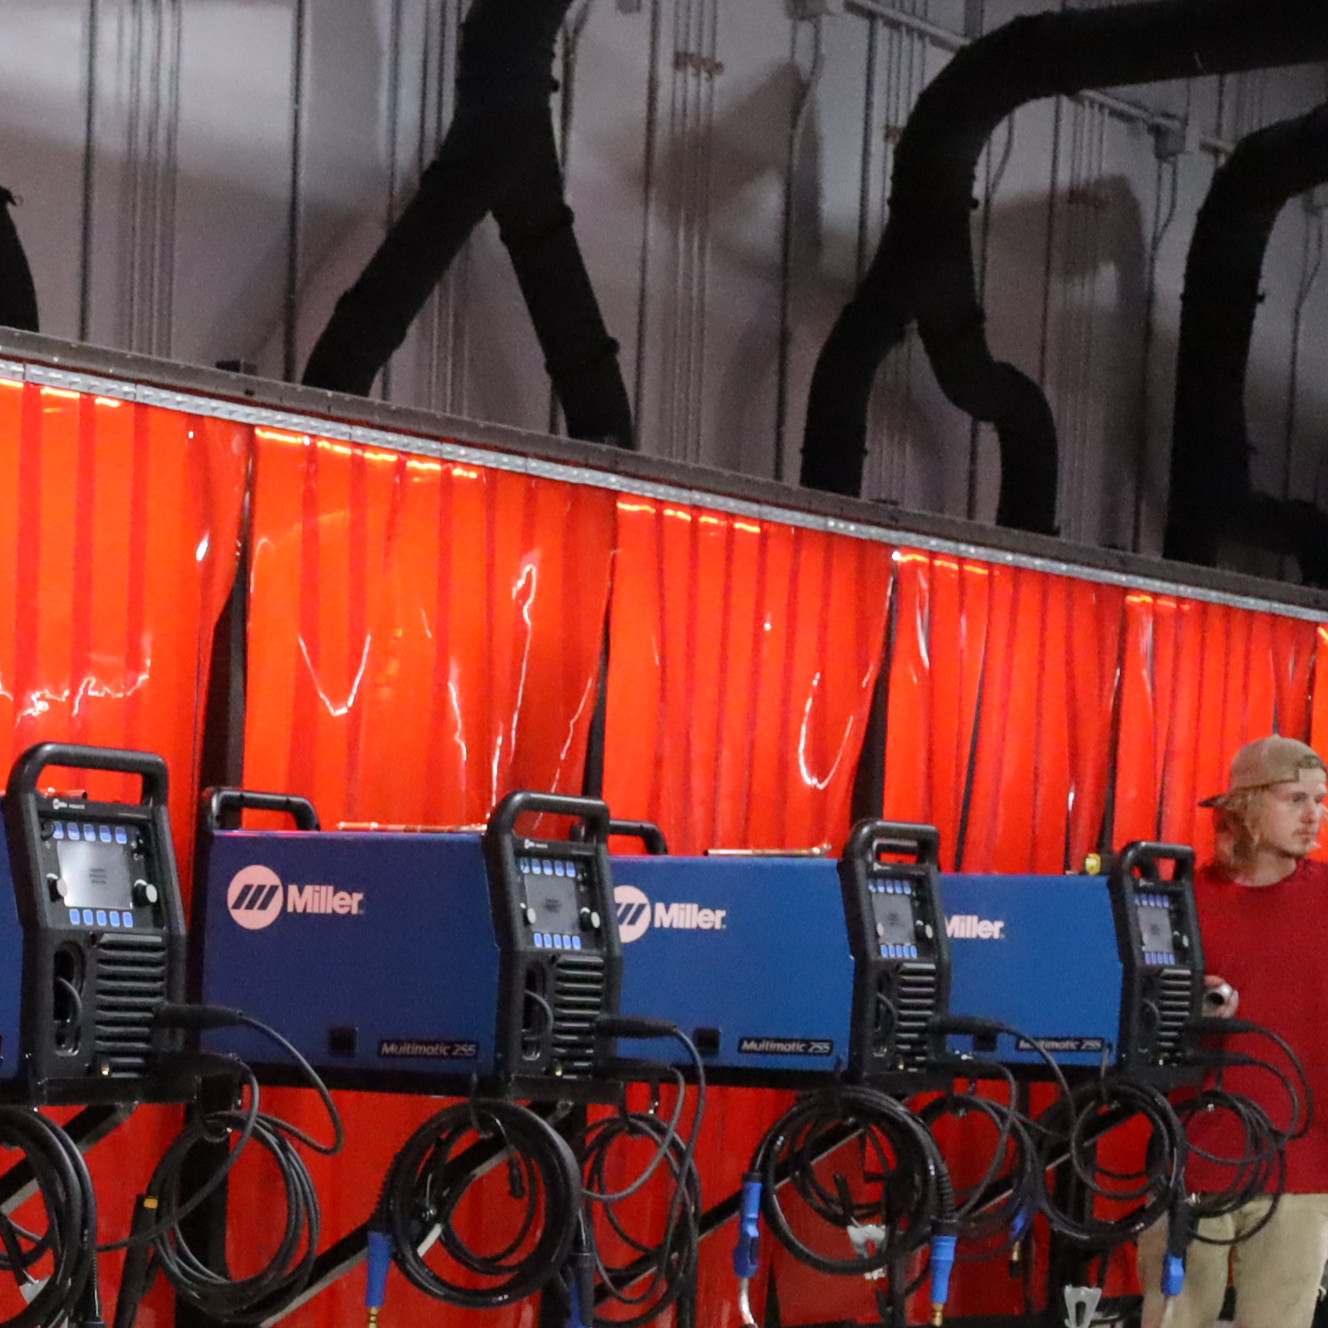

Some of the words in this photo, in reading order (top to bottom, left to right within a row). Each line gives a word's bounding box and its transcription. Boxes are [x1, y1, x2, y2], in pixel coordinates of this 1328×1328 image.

[287, 884, 364, 915] Miller
[653, 902, 726, 930] Miller
[381, 1043, 450, 1056] Multimatic
[742, 1040, 806, 1052] Multimatic
